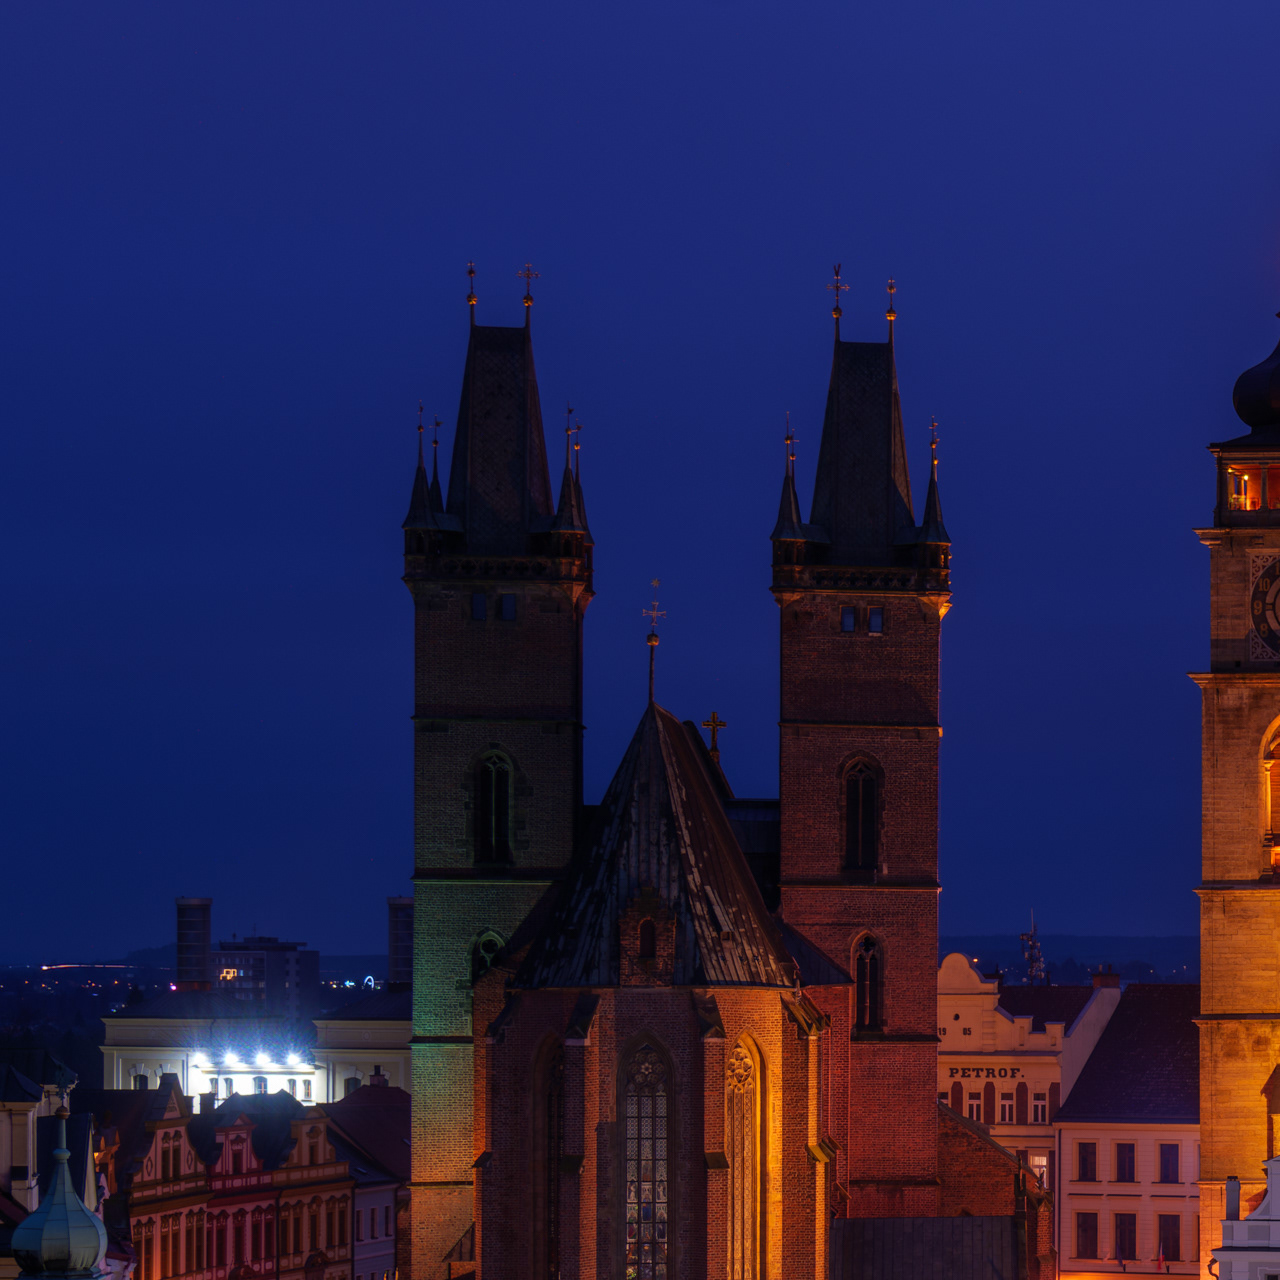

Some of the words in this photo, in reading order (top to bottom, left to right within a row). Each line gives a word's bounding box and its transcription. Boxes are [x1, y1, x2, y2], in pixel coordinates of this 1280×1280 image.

[1258, 578, 1271, 592] 10
[1253, 600, 1263, 615] 9
[1260, 623, 1269, 637] 8
